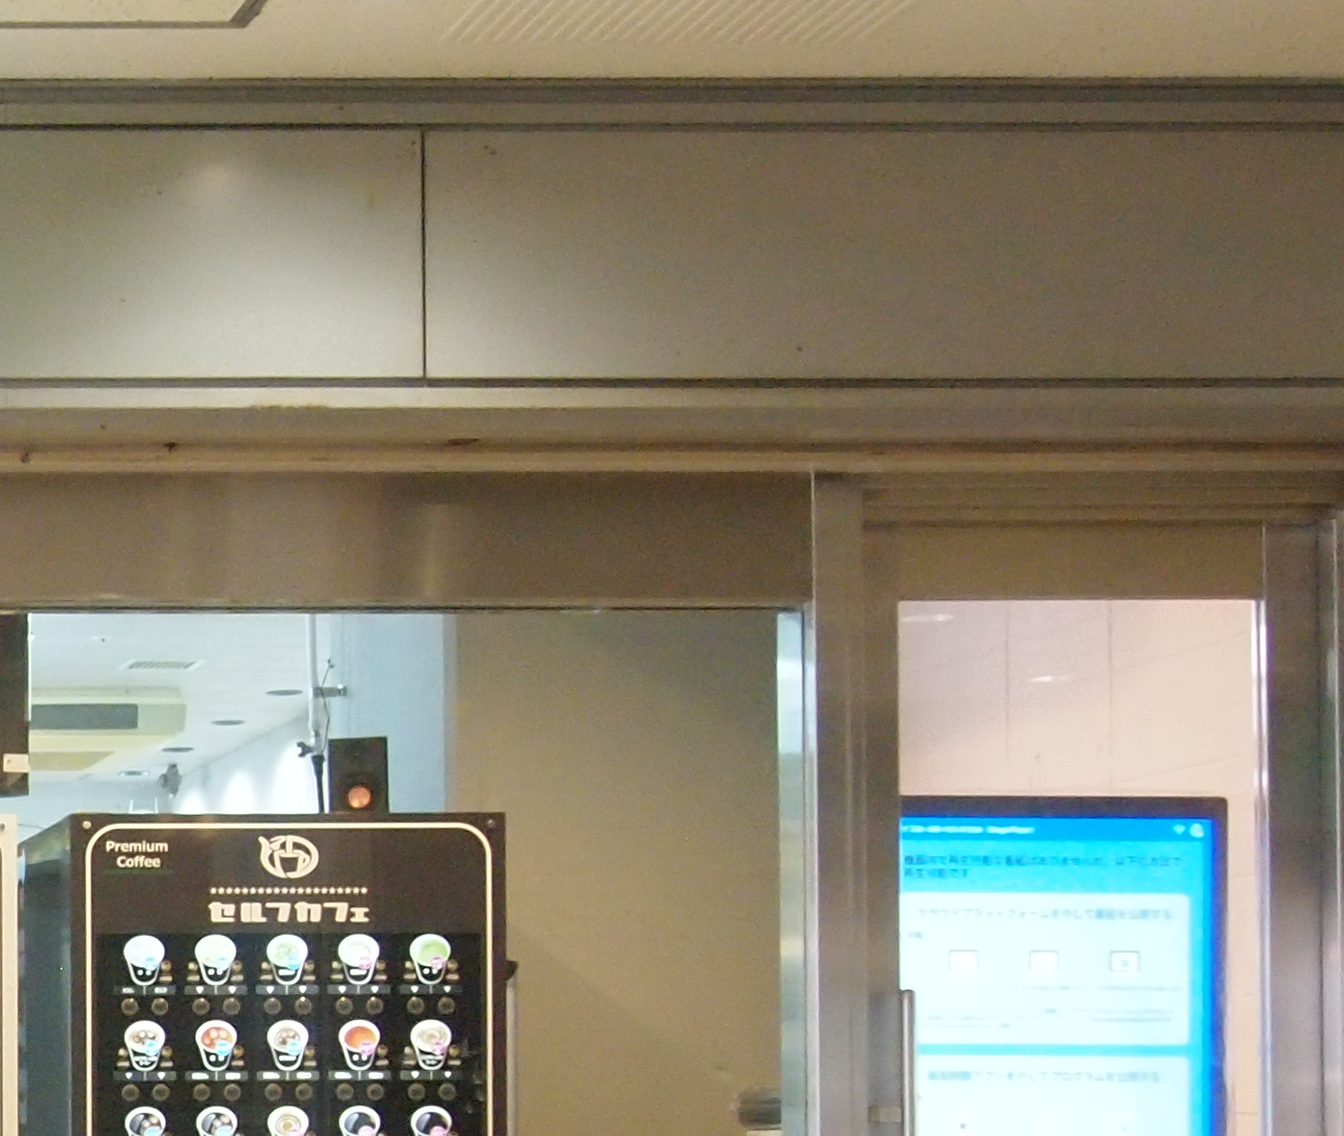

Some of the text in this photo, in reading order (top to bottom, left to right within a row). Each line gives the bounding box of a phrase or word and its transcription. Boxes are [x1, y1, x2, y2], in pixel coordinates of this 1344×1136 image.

[105, 840, 169, 853] Premium
[116, 855, 161, 868] Coffee
[208, 901, 370, 923] セルフカフェ
